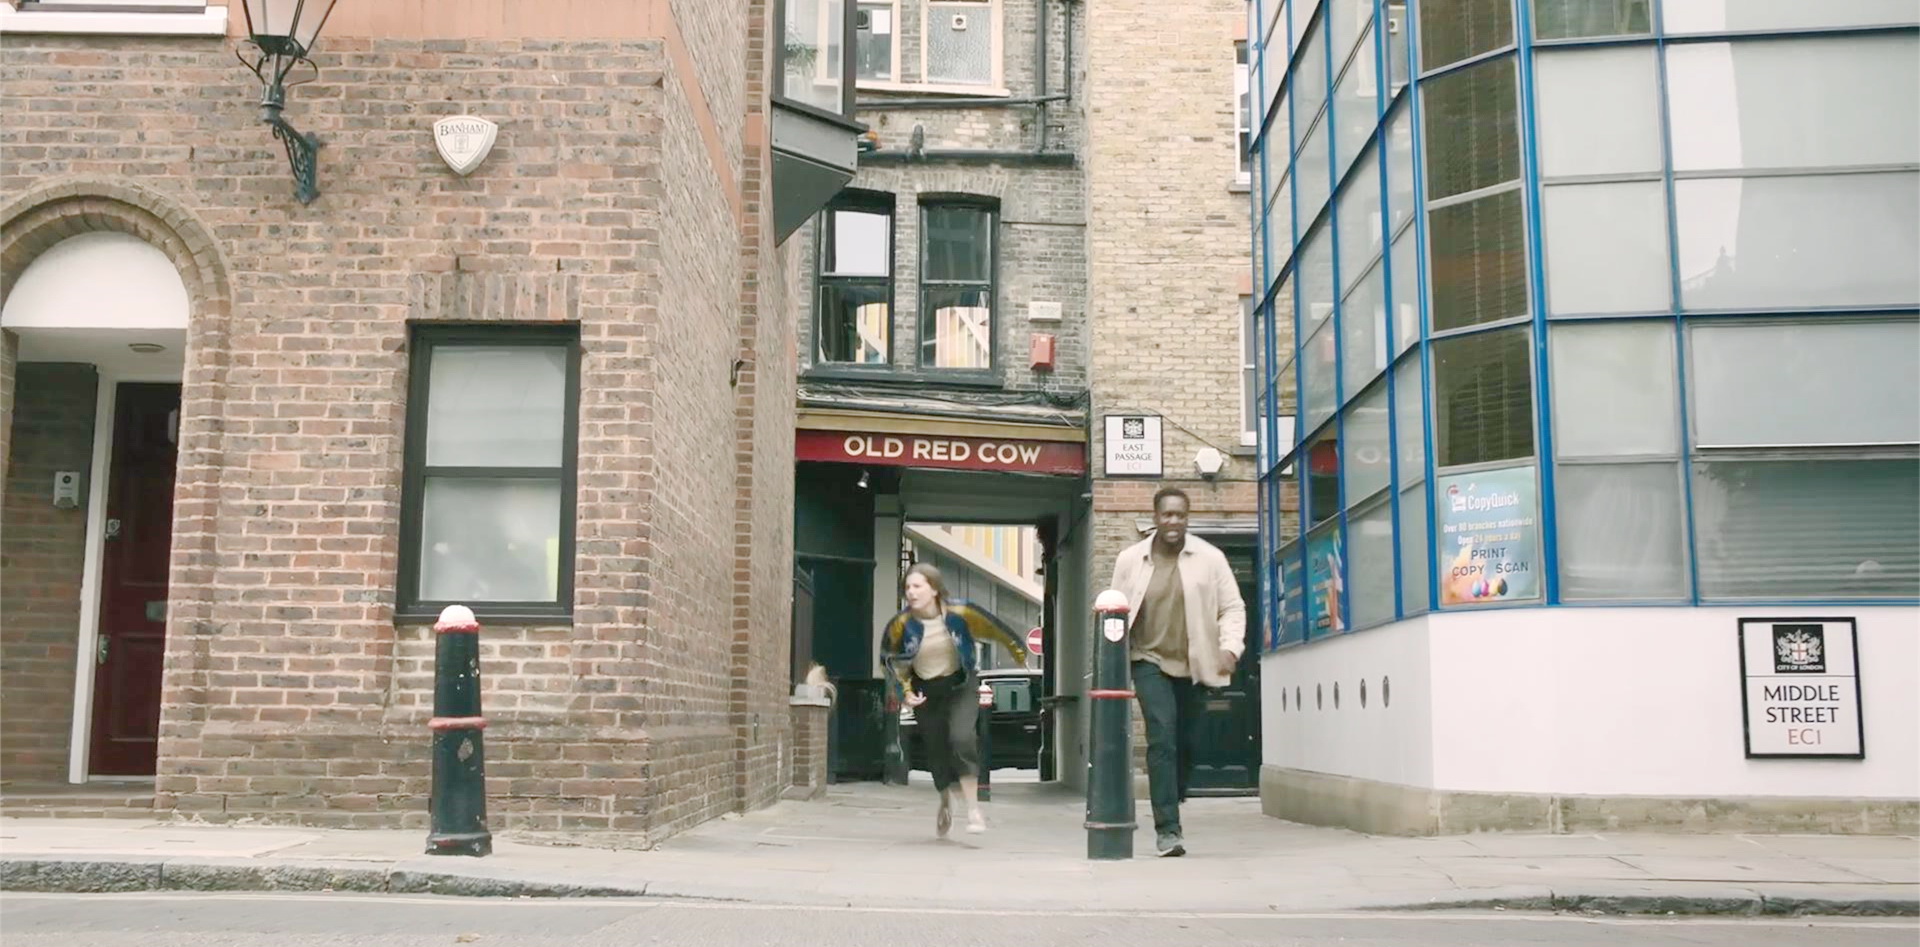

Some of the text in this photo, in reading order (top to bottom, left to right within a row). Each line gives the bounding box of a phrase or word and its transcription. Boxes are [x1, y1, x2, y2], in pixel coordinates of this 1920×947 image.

[440, 123, 484, 136] BANHAM
[843, 435, 1042, 465] OLD RED COW
[1122, 443, 1144, 451] EAST
[1114, 452, 1152, 461] PASSAGE
[1468, 491, 1519, 511] CopyQuick
[1443, 523, 1457, 533] Over
[1468, 521, 1497, 531] branches
[1498, 517, 1534, 528] nationwide
[1457, 534, 1473, 546] Open
[1471, 547, 1506, 560] PRINT
[1452, 561, 1529, 577] COPY SCAN
[1764, 685, 1840, 701] MIDDLE
[1766, 706, 1839, 723] STREET
